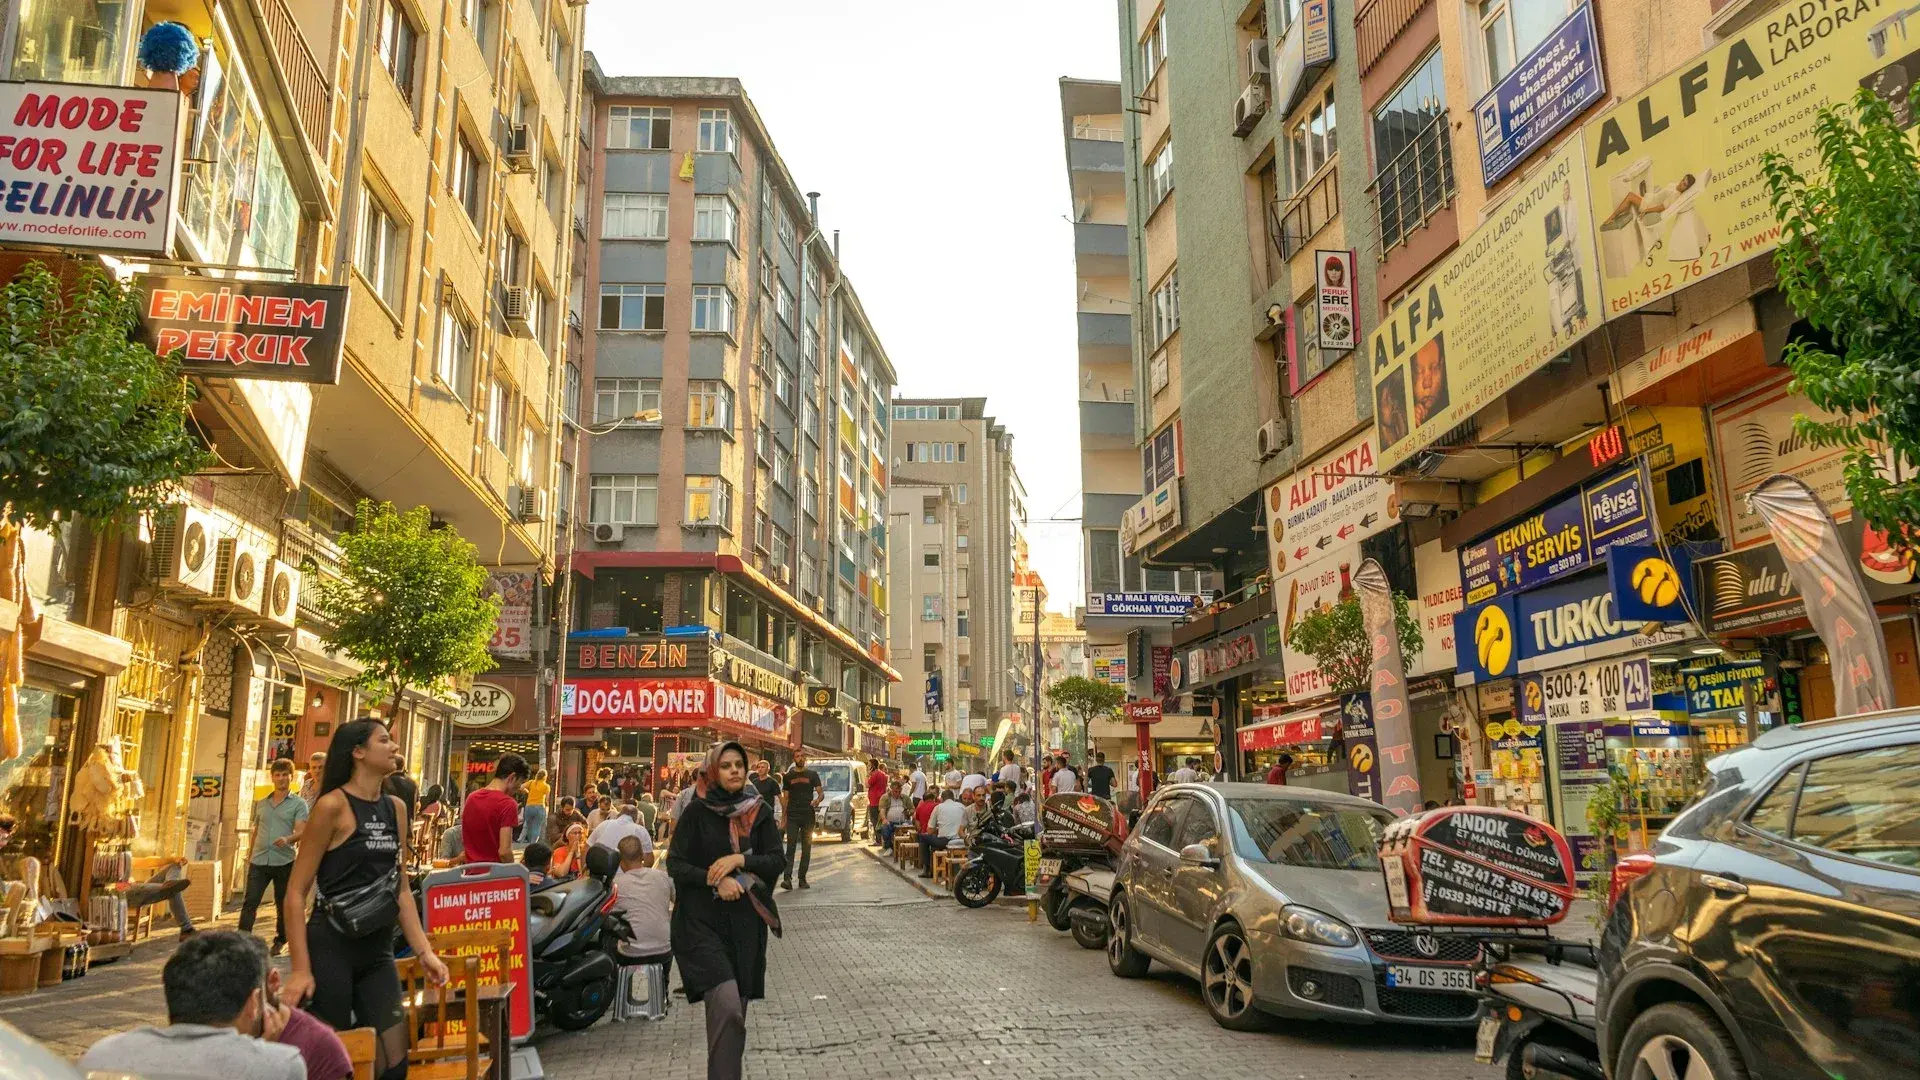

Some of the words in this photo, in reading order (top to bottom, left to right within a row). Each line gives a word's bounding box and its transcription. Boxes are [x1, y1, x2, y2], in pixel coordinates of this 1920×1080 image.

[1519, 36, 1566, 88] Serbest
[1510, 41, 1581, 115] Muhasebeci
[1723, 88, 1770, 121] BOYUTLU
[1773, 54, 1832, 92] ULTRASON
[1509, 106, 1534, 133] Mali
[1537, 59, 1585, 109] Müşavir
[1595, 38, 1765, 169] ALFA
[1731, 101, 1783, 135] EXTREMITY
[1786, 83, 1817, 107] EMAR
[13, 93, 148, 134] MODE
[0, 136, 68, 176] FOR
[77, 140, 163, 178] LIFE
[1725, 134, 1761, 158] DENTAL
[0, 176, 165, 225] ELİNLİK
[1442, 230, 1492, 290] RADYOLOJİ
[1492, 156, 1570, 243] LABORATUVARI
[1321, 288, 1349, 296] PERUK
[1612, 274, 1673, 313] tel:452
[1680, 260, 1703, 284] 76
[1710, 244, 1733, 269] 27
[148, 287, 328, 329] EMİNEM
[1322, 295, 1349, 307] SAÇ
[1373, 283, 1445, 377] ALFA
[156, 328, 313, 367] PERUK
[1649, 346, 1674, 373] ulu
[1290, 466, 1318, 511] ALİ
[1323, 441, 1374, 491] USTA
[1331, 482, 1358, 508] BAKLAVA
[1495, 513, 1548, 556] TEKNİK
[1526, 523, 1583, 569] SERVİS
[1466, 560, 1491, 578] SAMSUNG
[1470, 574, 1490, 590] NOKIA
[1748, 566, 1776, 596] ulu
[1300, 580, 1319, 596] DAVUT
[1321, 570, 1336, 587] BÜFE
[1112, 604, 1152, 613] GÖKHAN
[1156, 605, 1185, 613] YILDIZ
[1125, 594, 1148, 602] MALİ
[1149, 593, 1191, 603] MÜŞAVİR
[1423, 592, 1444, 609] YILDIZ
[579, 638, 688, 669] BENZİN
[1632, 635, 1657, 649] Nevsa
[1288, 669, 1318, 696] KÖFTE
[1546, 673, 1573, 701] 500
[1579, 671, 1589, 696] 2
[1596, 664, 1620, 698] 100
[1700, 670, 1726, 687] PEŞİN
[578, 682, 635, 714] DOĞA
[639, 682, 706, 714] DÖNER
[1580, 700, 1590, 715] GB
[1602, 697, 1618, 713] SMS
[1692, 690, 1711, 710] 12
[455, 708, 499, 719] perfumum
[1243, 731, 1255, 747] ÇAY
[1273, 725, 1286, 743] ÇAY
[1302, 719, 1316, 737] ÇAY
[365, 822, 386, 830] COULD
[1449, 812, 1510, 839] ANDOK
[1456, 828, 1471, 839] ET
[1471, 833, 1513, 854] MANGAL
[1516, 846, 1560, 867] DÜNYASI
[1421, 848, 1447, 869] TEL:
[1451, 860, 1475, 878] 552
[1475, 866, 1490, 883] 41
[1490, 872, 1507, 889] 75
[1531, 888, 1549, 904] 49
[433, 893, 467, 909] LİMAN
[469, 888, 521, 905] İNTERNET
[1438, 886, 1465, 904] 0539
[1465, 893, 1485, 910] 345
[1484, 898, 1498, 913] 51
[1497, 902, 1512, 917] 76
[464, 906, 491, 921] CAFE
[1396, 968, 1412, 985] 34
[1420, 970, 1435, 987] DS
